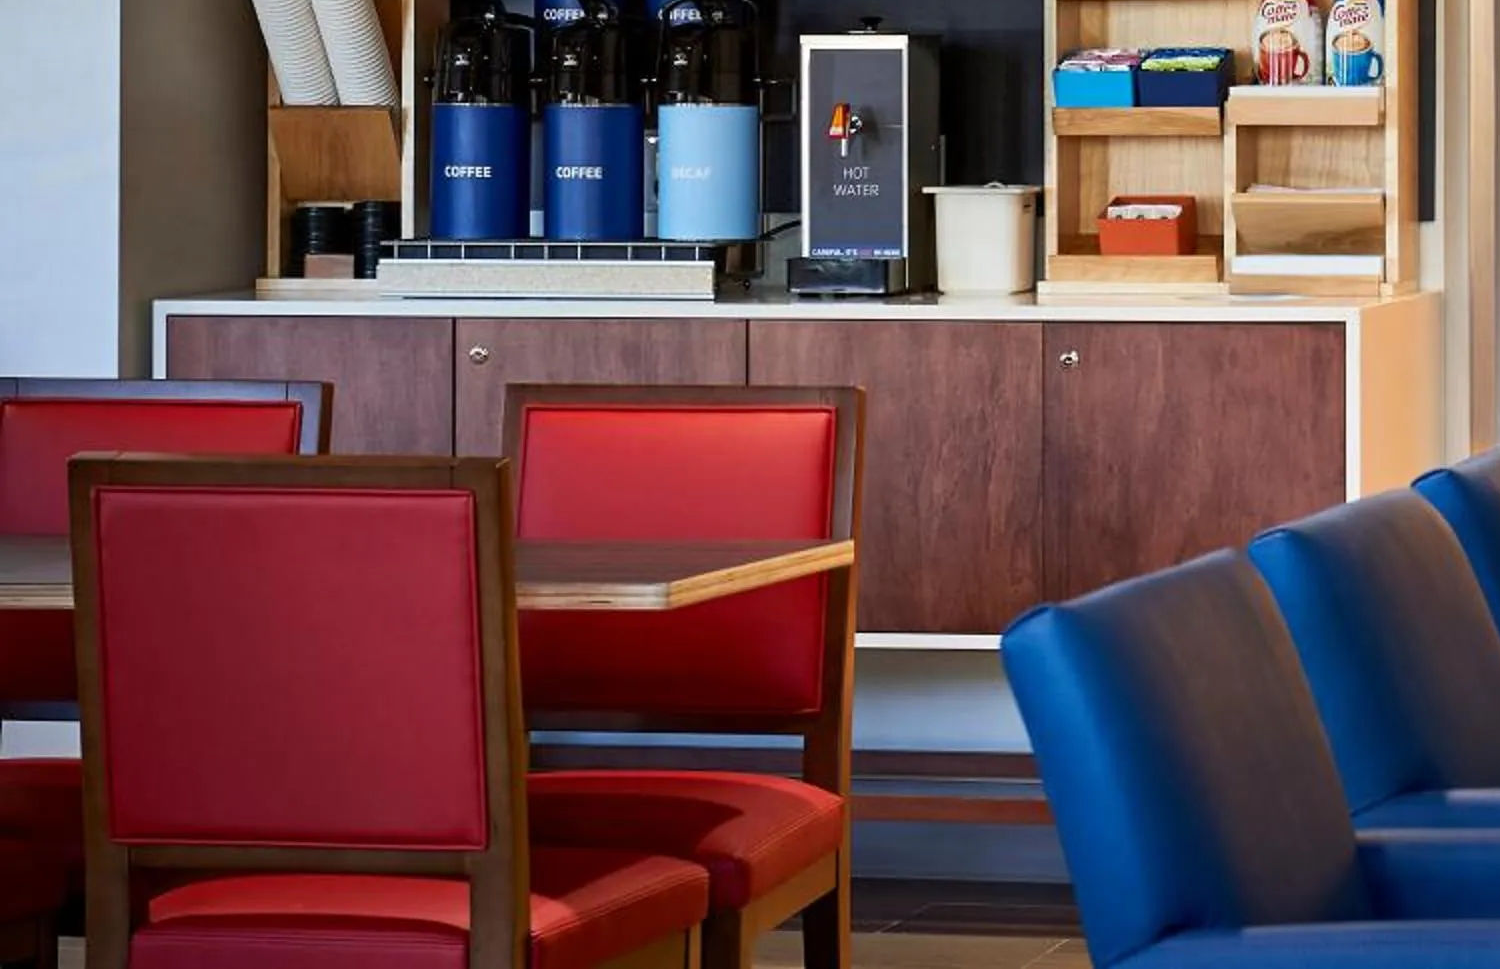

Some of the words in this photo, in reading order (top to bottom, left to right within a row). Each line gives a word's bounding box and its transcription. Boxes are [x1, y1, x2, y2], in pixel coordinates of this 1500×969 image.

[444, 166, 493, 178] COFFEE
[555, 166, 603, 179] COFFEE
[843, 166, 871, 180] HOT
[833, 184, 880, 196] WATER
